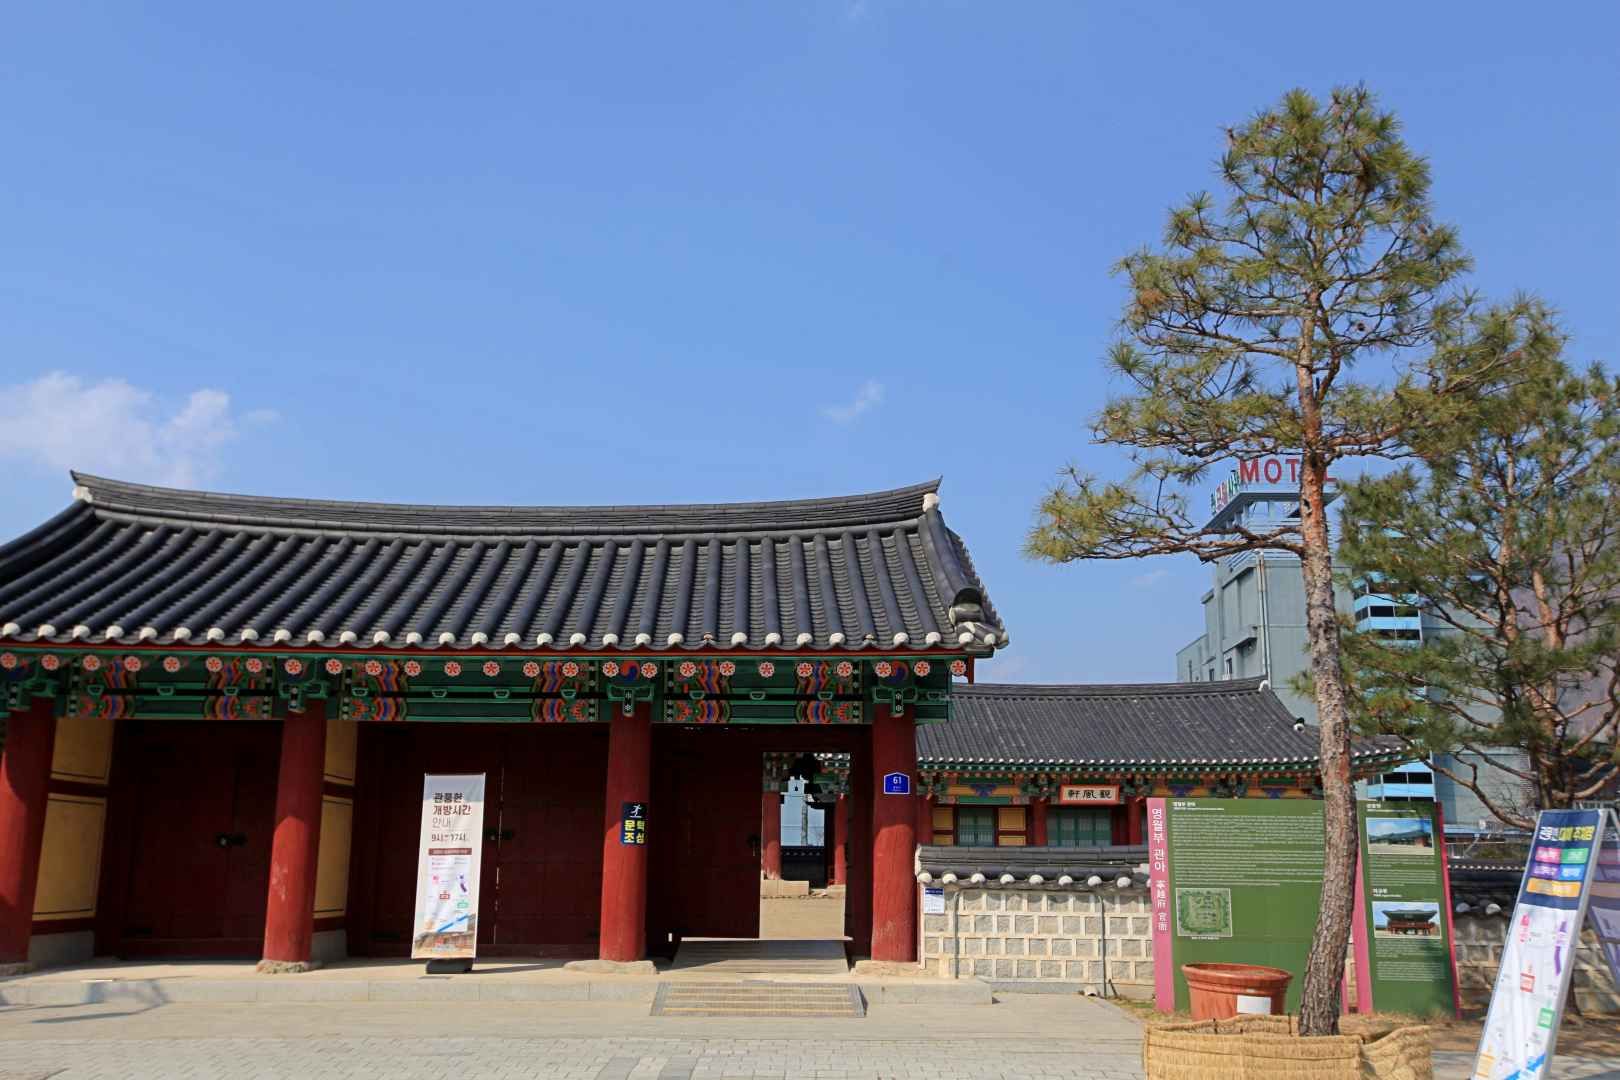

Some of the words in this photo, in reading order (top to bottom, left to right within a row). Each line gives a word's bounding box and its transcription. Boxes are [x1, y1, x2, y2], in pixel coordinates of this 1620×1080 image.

[1239, 457, 1337, 483] MOTL
[893, 776, 902, 785] 61
[432, 804, 472, 816] 개방시간
[432, 817, 450, 828] 안내
[624, 832, 645, 844] 조심
